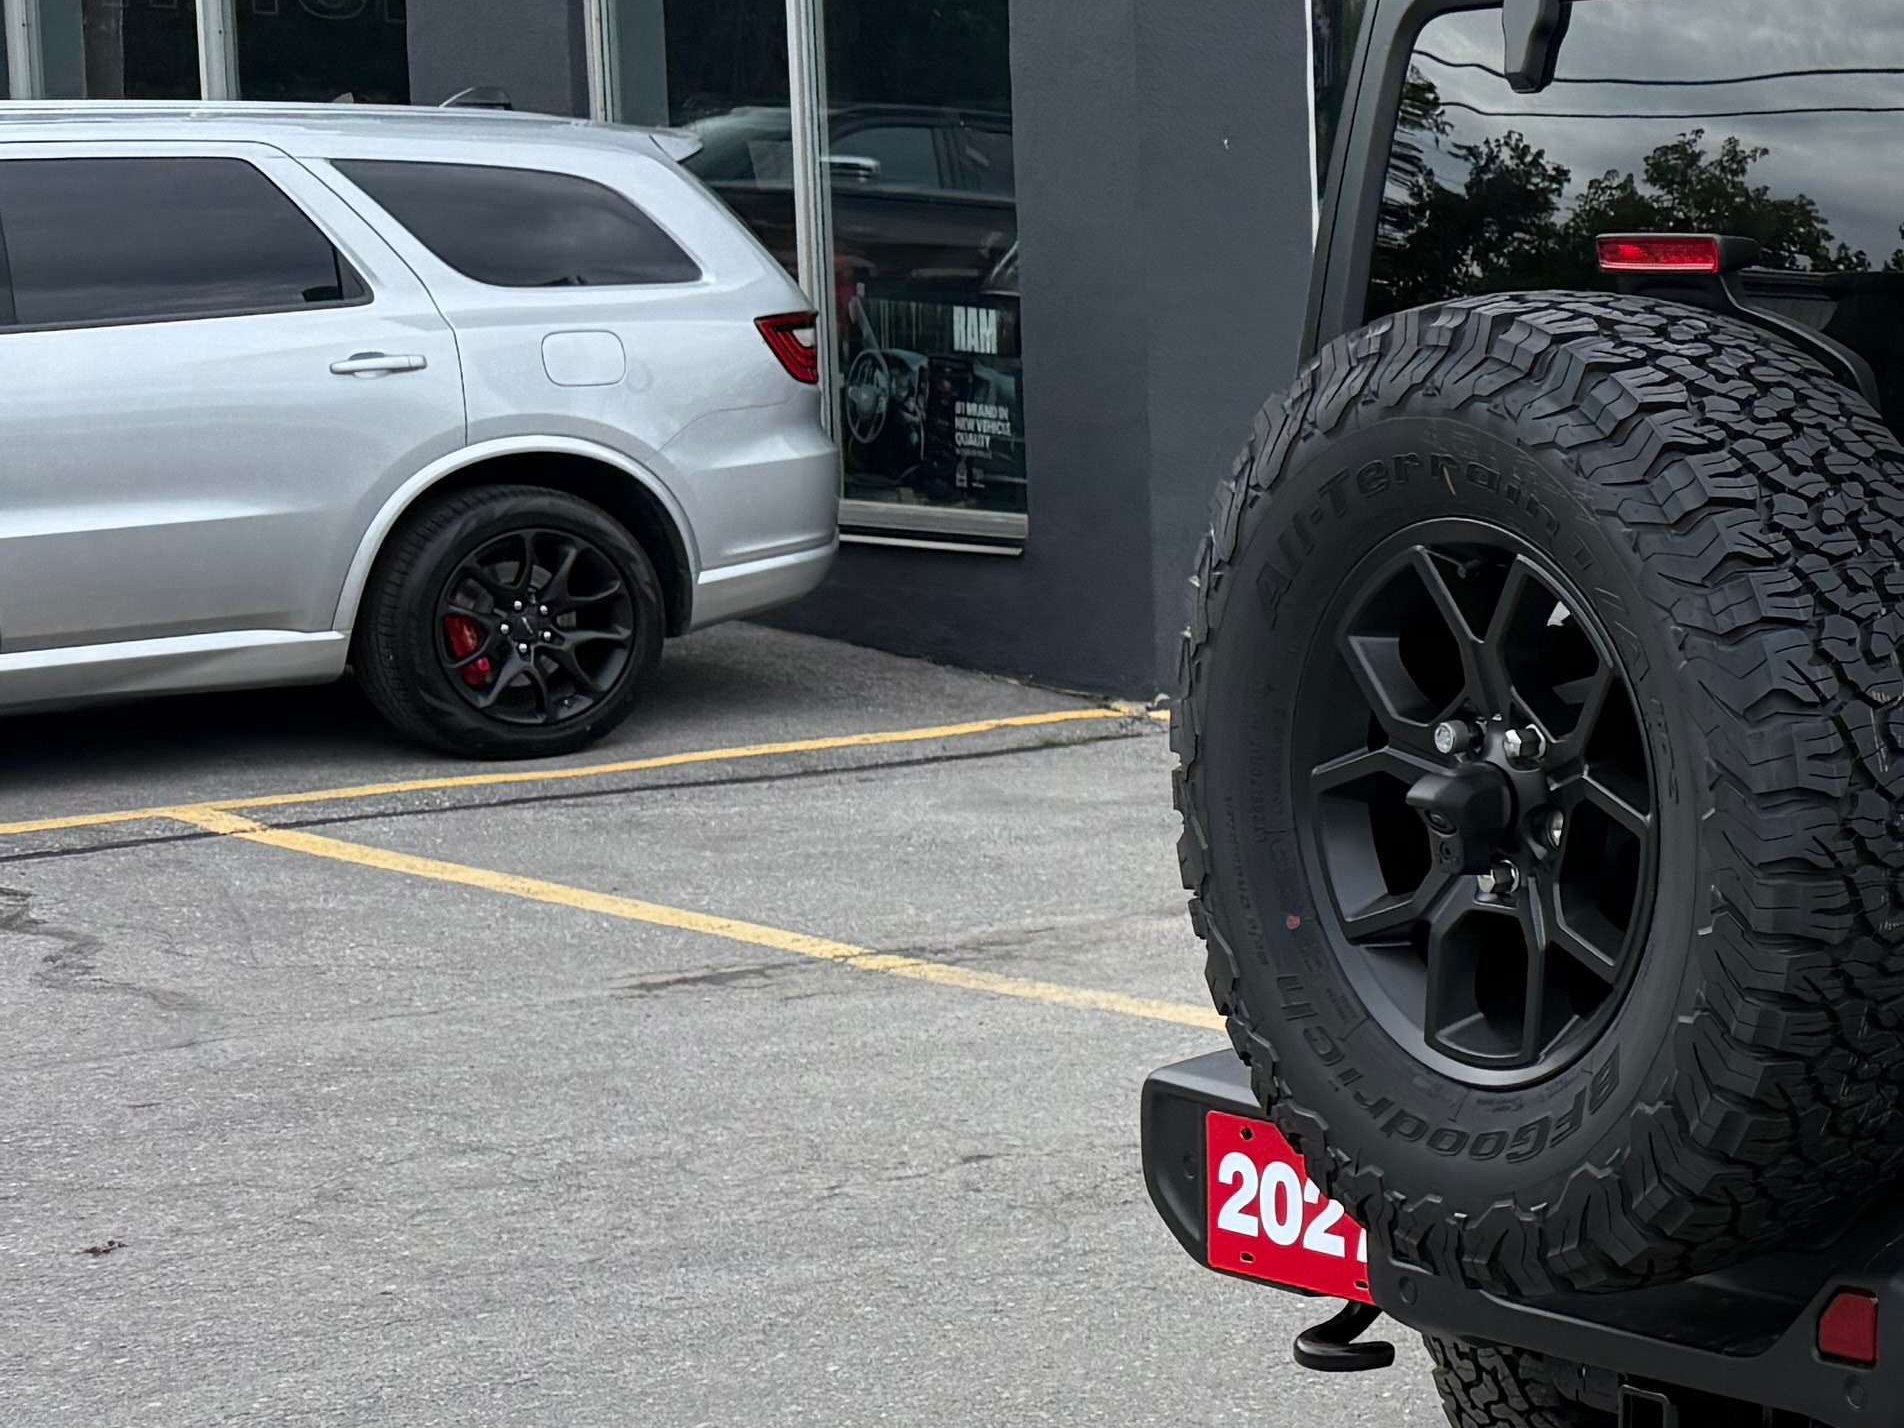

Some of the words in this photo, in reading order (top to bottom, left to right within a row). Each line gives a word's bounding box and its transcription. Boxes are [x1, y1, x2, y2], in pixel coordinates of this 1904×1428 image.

[952, 305, 999, 355] RAM
[954, 432, 990, 450] QUALITY
[1275, 973, 1621, 1164] BFGoodrich
[1216, 1151, 1368, 1264] 202
